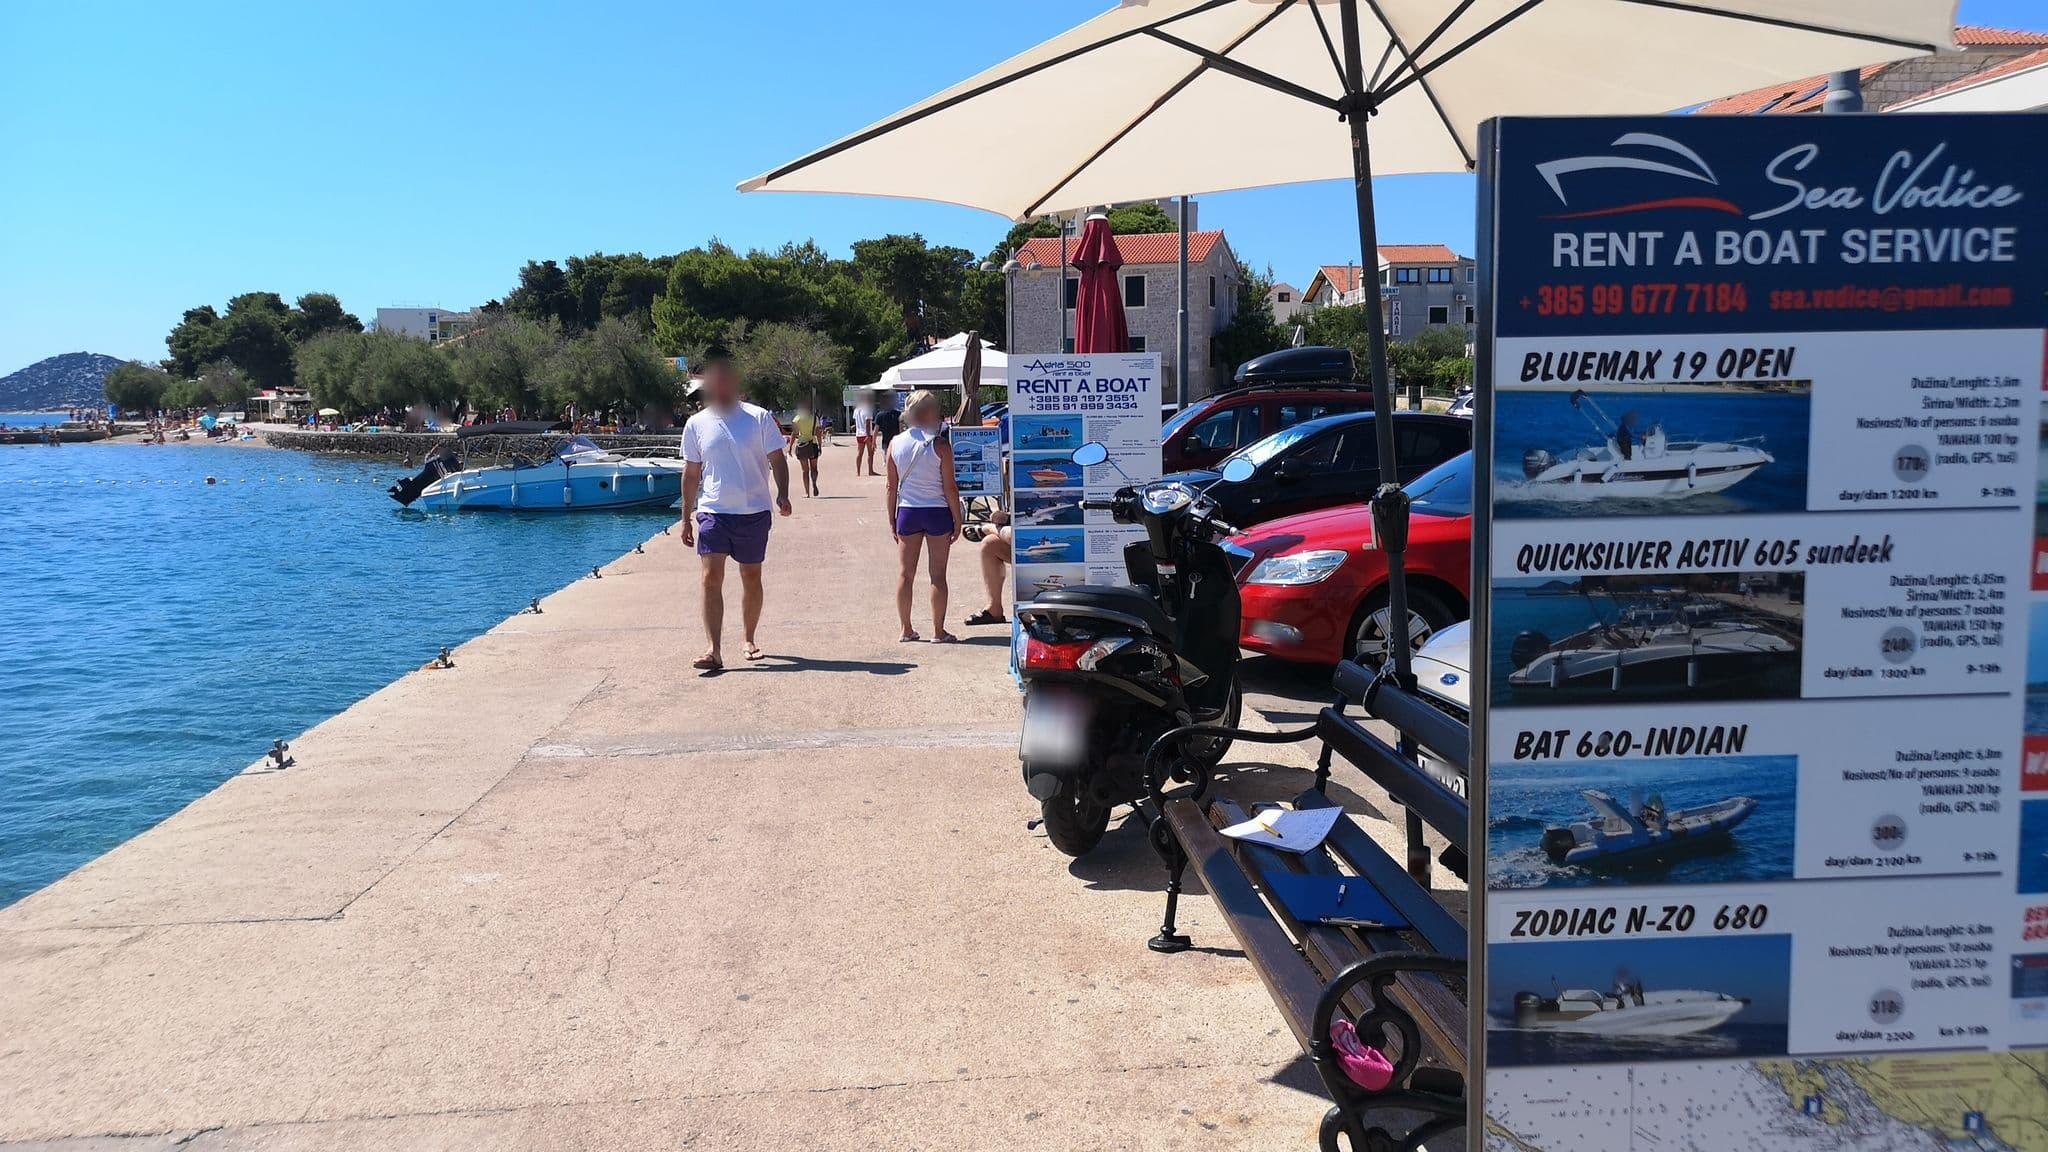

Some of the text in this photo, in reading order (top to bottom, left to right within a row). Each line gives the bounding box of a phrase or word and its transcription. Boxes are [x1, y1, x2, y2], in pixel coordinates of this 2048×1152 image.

[1748, 142, 2025, 220] Sea Vodice
[1552, 226, 2017, 268] RENT A BOAT SERVICE
[1537, 284, 1585, 316] 385
[1592, 284, 1626, 315] 99
[1630, 283, 1678, 314] 677
[1684, 281, 1747, 313] 7184
[1769, 284, 2014, 312] sea.vodice@gmail.com
[1023, 359, 1091, 374] Adria 500
[1520, 347, 1795, 382] BLUEMAX 19 OPEN
[1016, 377, 1151, 394] RENT A BOAT
[1029, 394, 1135, 403] +385 98 197 3551
[1029, 403, 1060, 411] +385
[1062, 403, 1077, 411] 91
[1105, 402, 1138, 410] 3434
[1839, 489, 1888, 502] day/dan
[1892, 489, 1920, 500] 1200
[1516, 533, 1895, 574] QUICKSILVER ACTIV 605 sundeck
[1824, 667, 1873, 680] day/dan
[1513, 724, 1748, 761] BAT 680-INDIAN
[1825, 856, 1873, 868] day/dan
[1510, 904, 1768, 937] ZODIAC N-ZO 680
